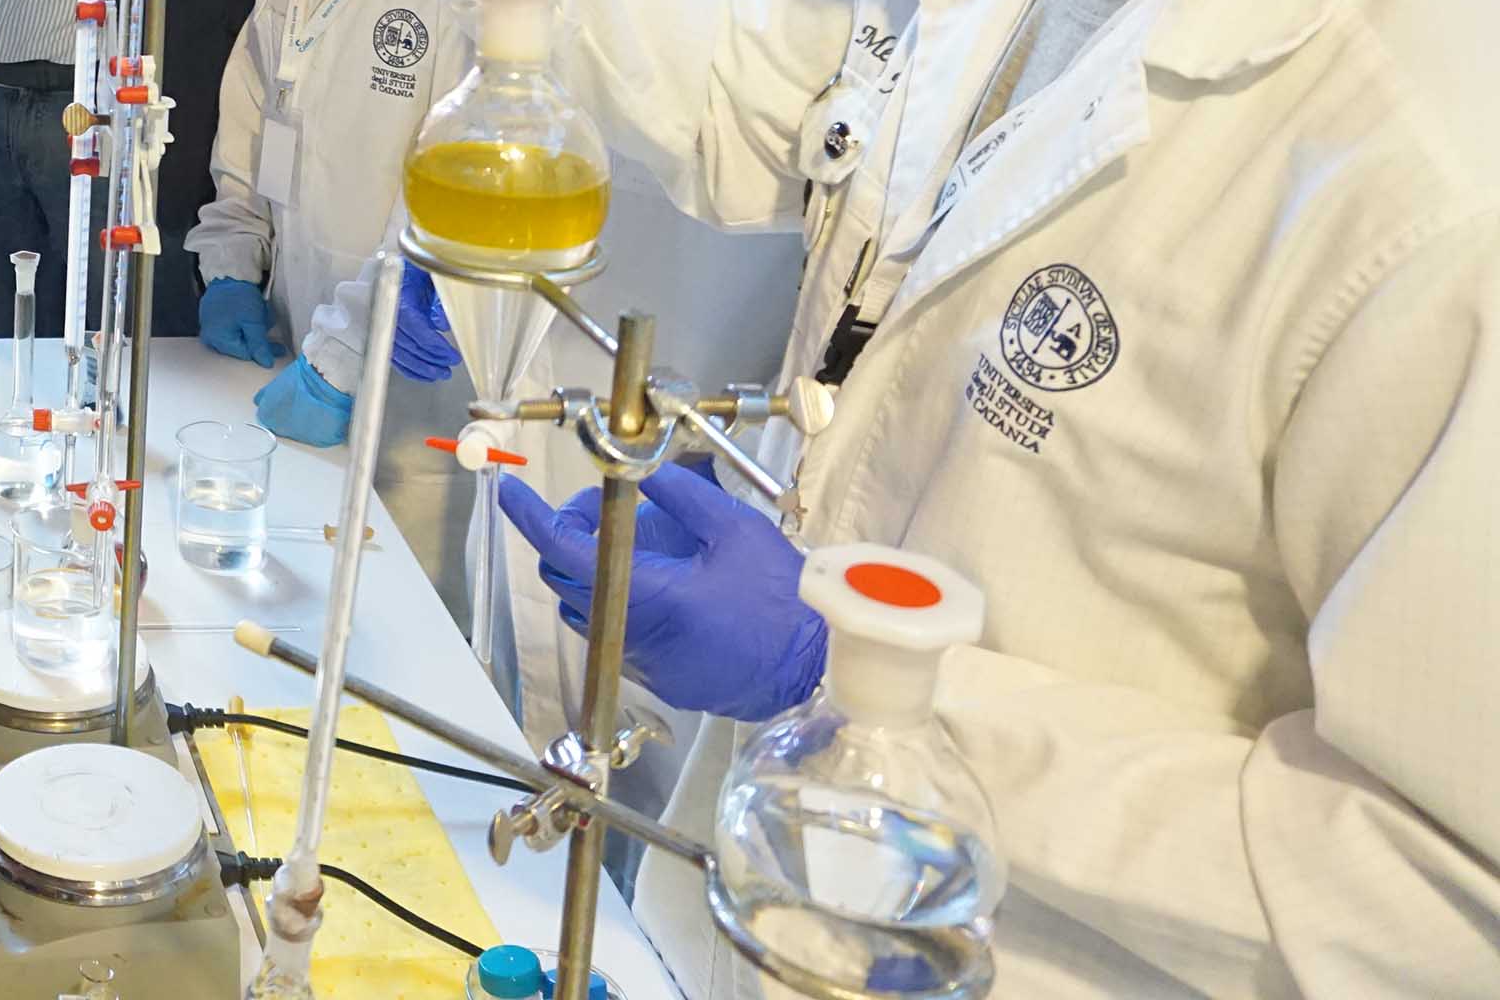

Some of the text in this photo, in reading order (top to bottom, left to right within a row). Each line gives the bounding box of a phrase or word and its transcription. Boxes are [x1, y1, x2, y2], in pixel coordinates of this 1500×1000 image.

[378, 84, 415, 98] CATANIA
[1004, 275, 1044, 331] SICILIAE
[1046, 268, 1097, 310] STVDIVM
[1009, 351, 1043, 384] 1434
[972, 398, 1041, 454] CATANIA
[995, 397, 1051, 440] STUDI
